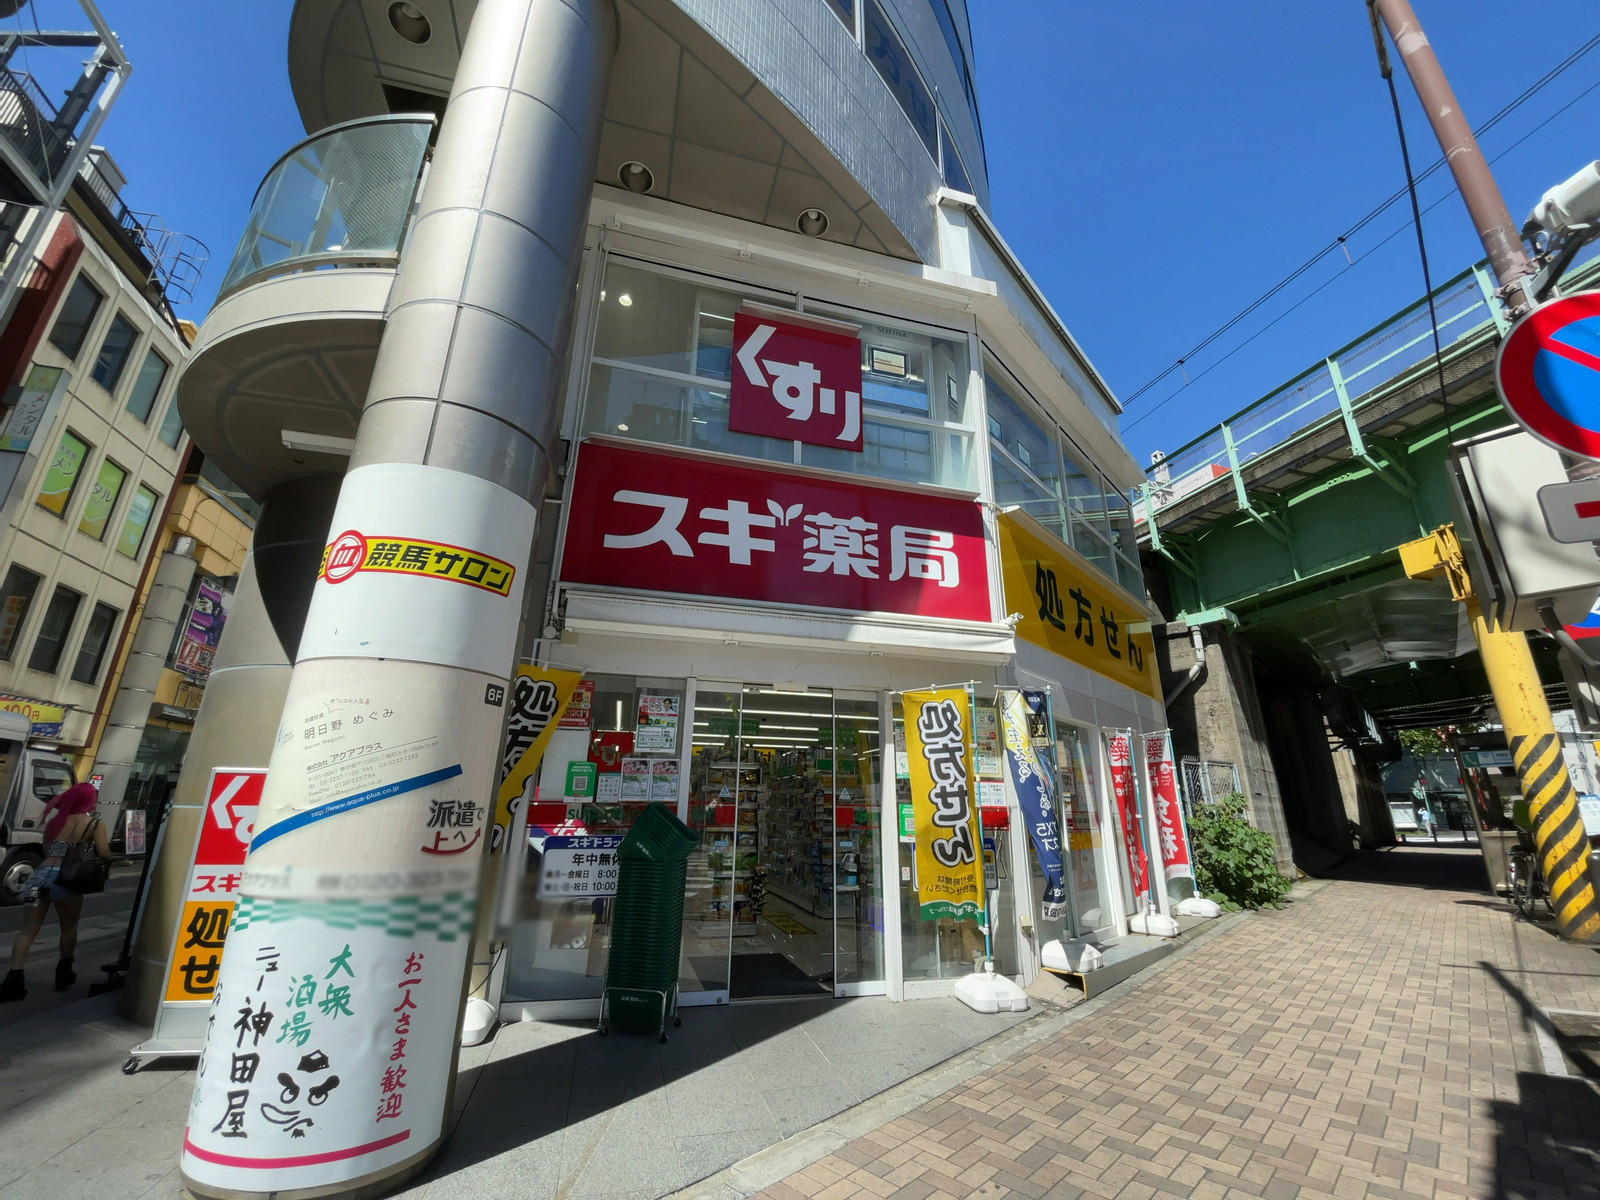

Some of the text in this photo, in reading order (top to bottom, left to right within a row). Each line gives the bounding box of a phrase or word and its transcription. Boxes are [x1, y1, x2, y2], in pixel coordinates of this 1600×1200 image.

[877, 327, 907, 339] SOFINA
[736, 324, 861, 442] くすり
[603, 489, 959, 588] スギ薬局
[365, 541, 511, 591] 競馬サロン
[1033, 558, 1144, 673] 処方せん
[488, 687, 503, 703] 6F
[304, 719, 343, 741] 明日野
[352, 708, 394, 725] めぐみ
[306, 742, 383, 772] 株式会社 アクアプラス
[310, 785, 400, 818] http://www.aqua-plus.co.jp
[427, 799, 485, 828] 派遣で
[567, 836, 625, 849] スギドラッ
[592, 882, 616, 891] 10:00
[318, 943, 355, 1020] 大衆
[276, 974, 318, 1048] 酒場
[211, 946, 281, 1139] ニュー神田屋
[376, 951, 425, 1123] お一人さま歓迎
